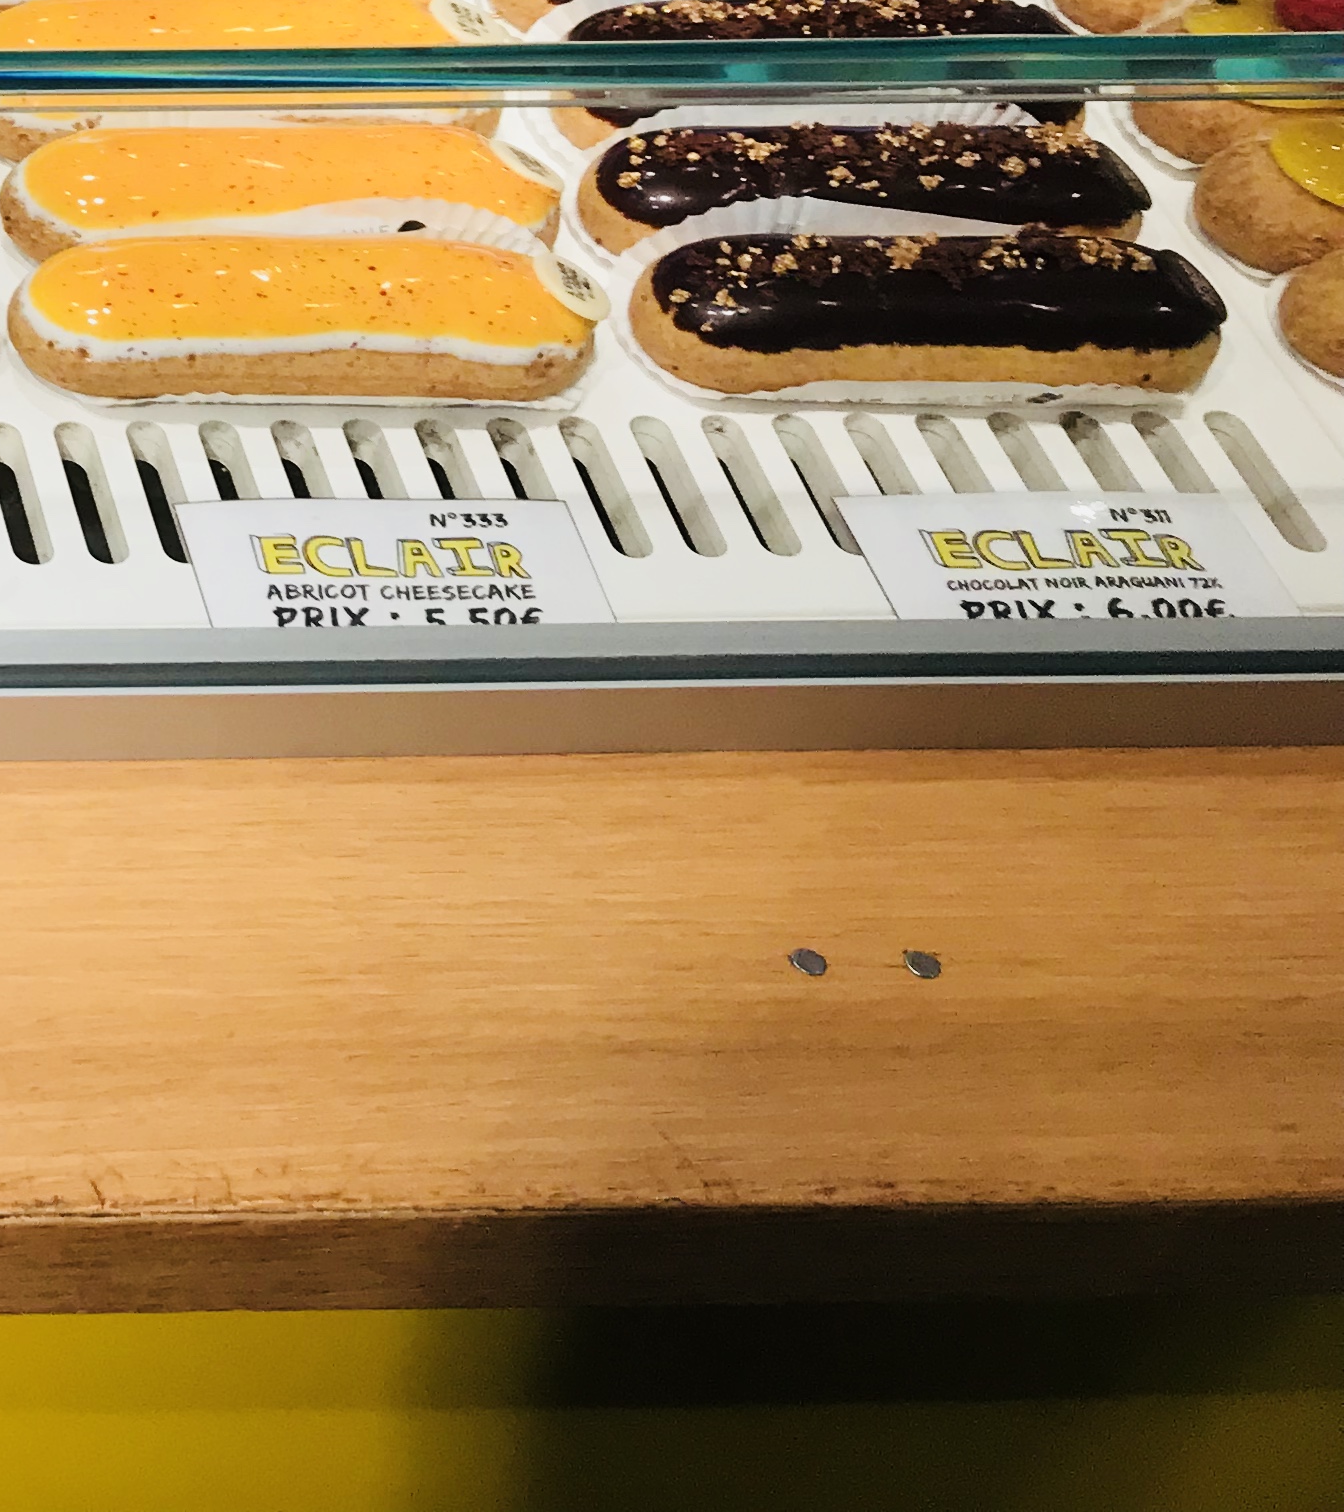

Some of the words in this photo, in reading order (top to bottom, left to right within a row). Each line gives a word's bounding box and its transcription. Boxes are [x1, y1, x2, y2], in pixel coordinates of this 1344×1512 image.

[429, 511, 509, 530] N°333
[249, 533, 532, 580] ECLAIR
[919, 527, 1207, 572] ECLAIR
[267, 583, 371, 601] ABRICOT
[379, 583, 537, 601] CHEESECAKE
[946, 578, 1040, 592] CHOCOLAT
[1045, 576, 1095, 590] NOIR
[1095, 575, 1186, 589] ARAGUANI
